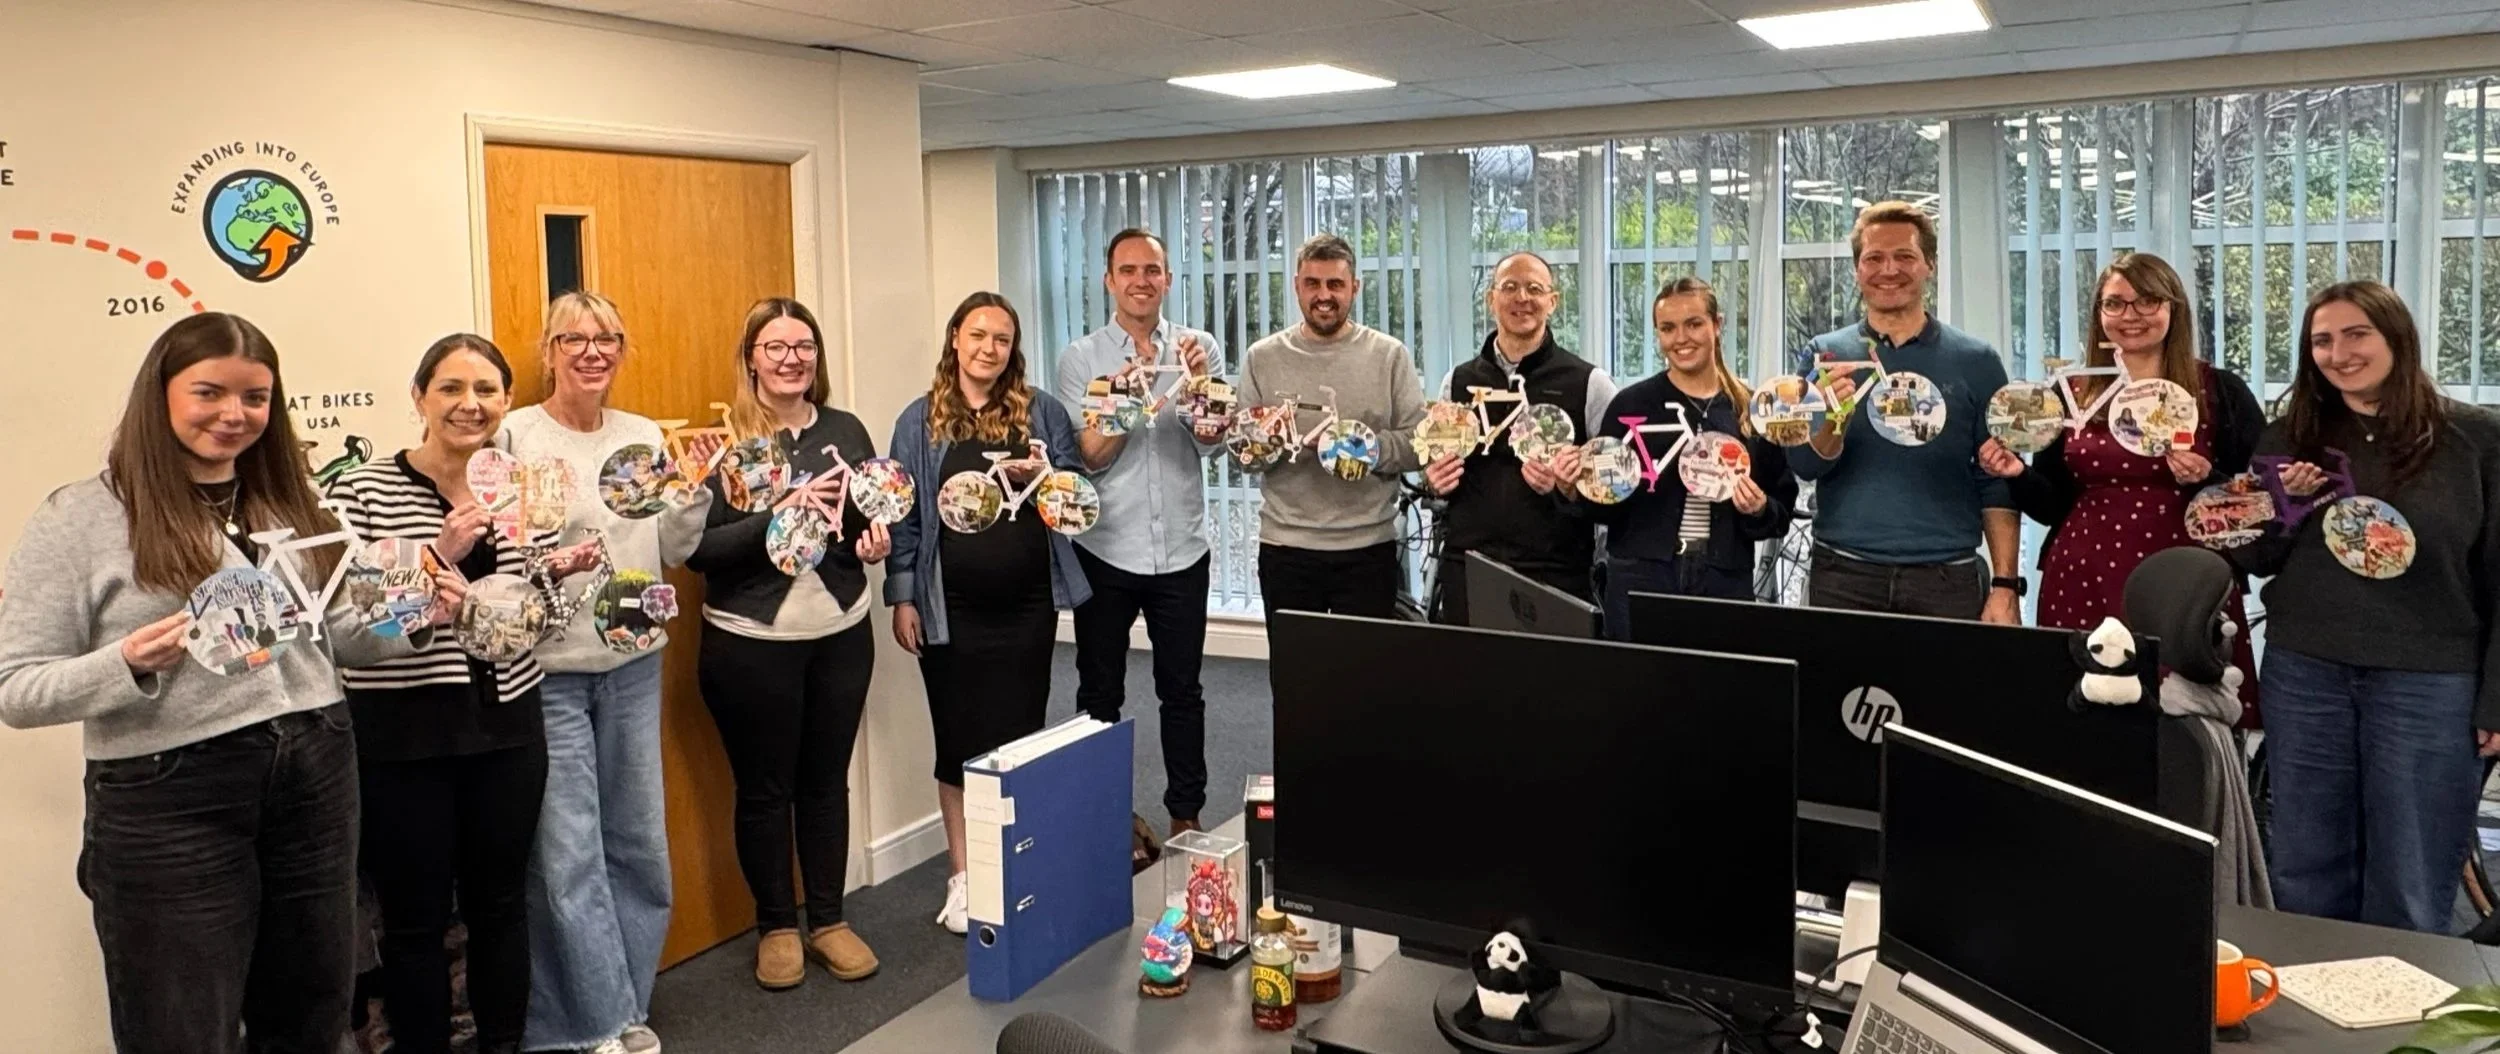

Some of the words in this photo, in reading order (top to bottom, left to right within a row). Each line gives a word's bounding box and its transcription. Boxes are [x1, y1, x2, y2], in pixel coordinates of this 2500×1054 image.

[171, 141, 246, 214] EXPANDING
[255, 141, 297, 163] INTO
[299, 161, 340, 225] EUROPE
[107, 295, 165, 317] 2016
[322, 392, 374, 409] BIKES
[307, 416, 341, 430] USA
[381, 568, 422, 588] NEW!
[1847, 686, 1899, 743] hp
[1280, 897, 1314, 913] Lenovo
